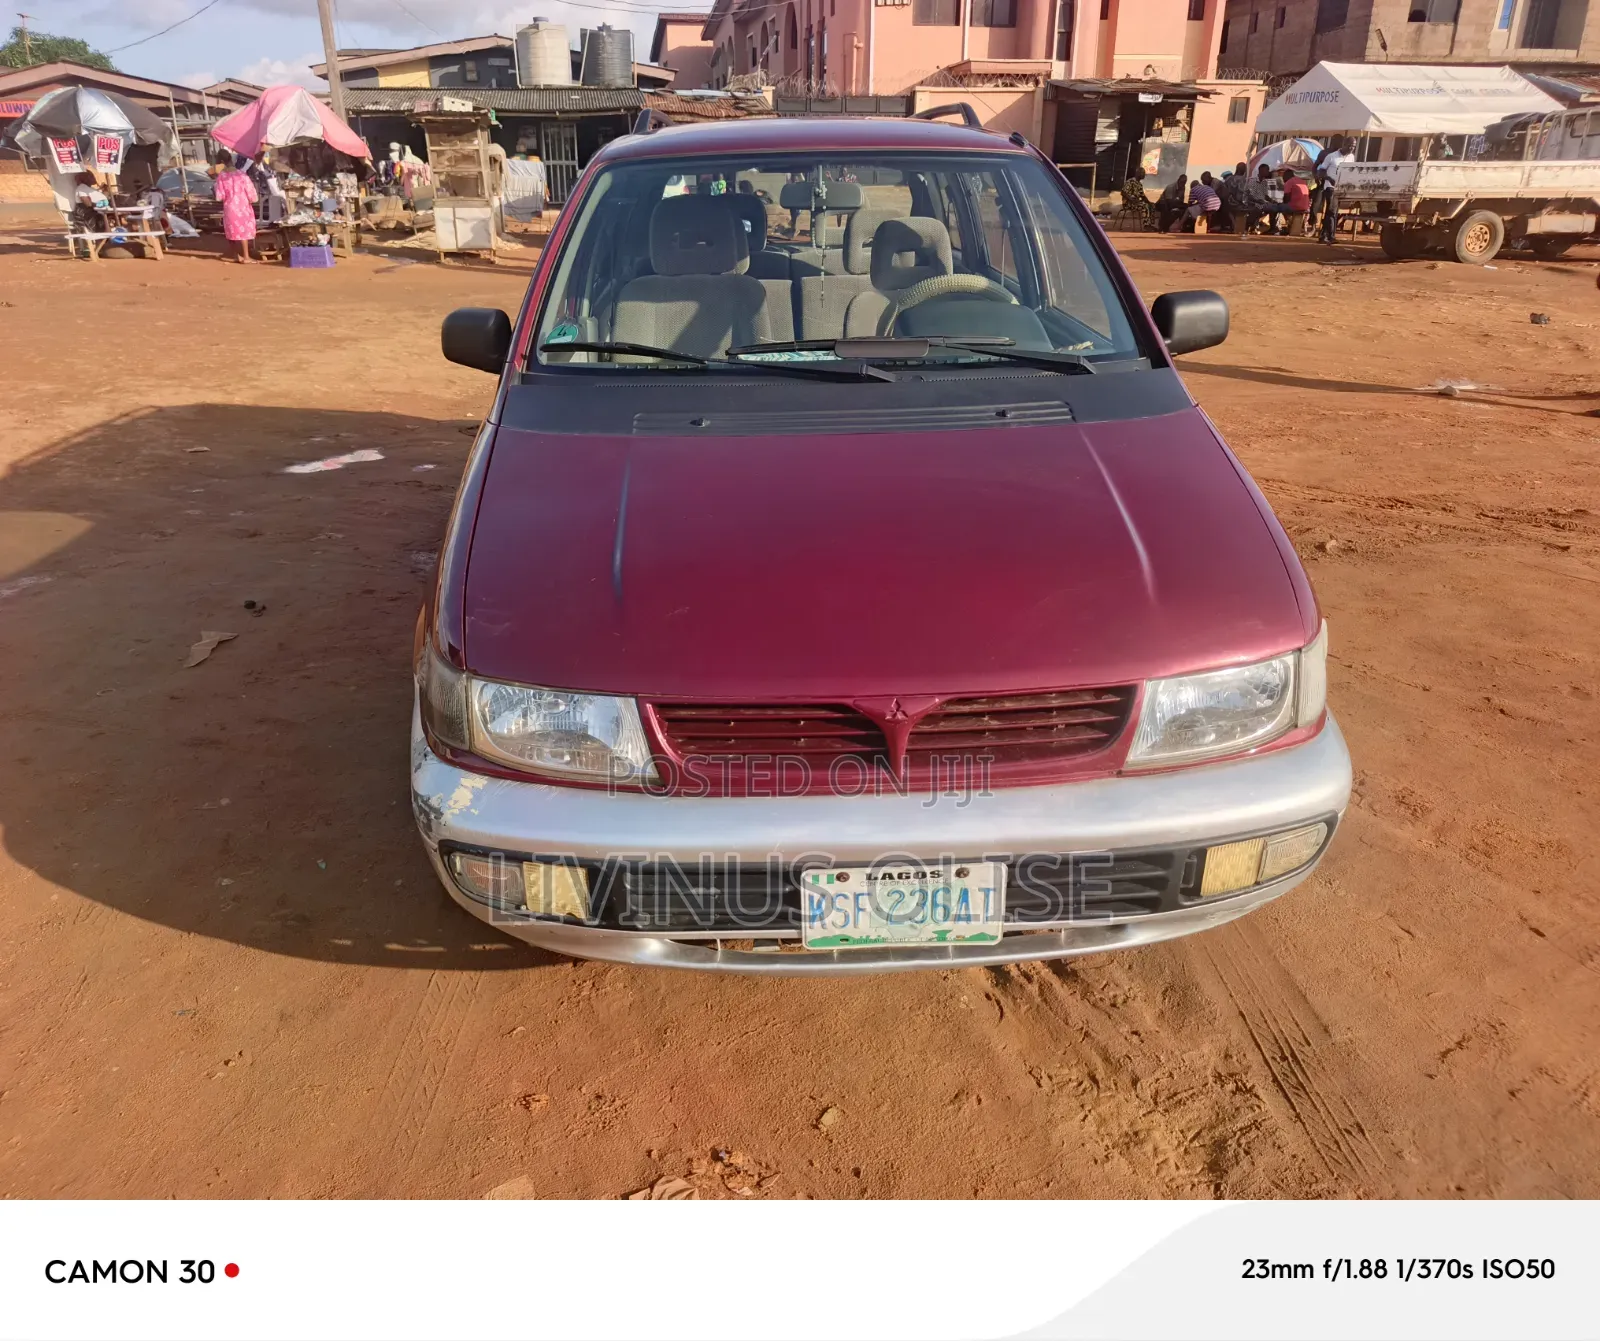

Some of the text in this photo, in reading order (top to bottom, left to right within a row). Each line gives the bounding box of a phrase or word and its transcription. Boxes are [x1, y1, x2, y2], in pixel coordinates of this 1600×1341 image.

[1376, 87, 1446, 95] MULTIPURPOSE
[1285, 91, 1340, 105] MULTIPURPOSE
[98, 137, 120, 150] POS
[866, 870, 944, 881] LAGOS
[808, 887, 996, 929] KSF 236AT
